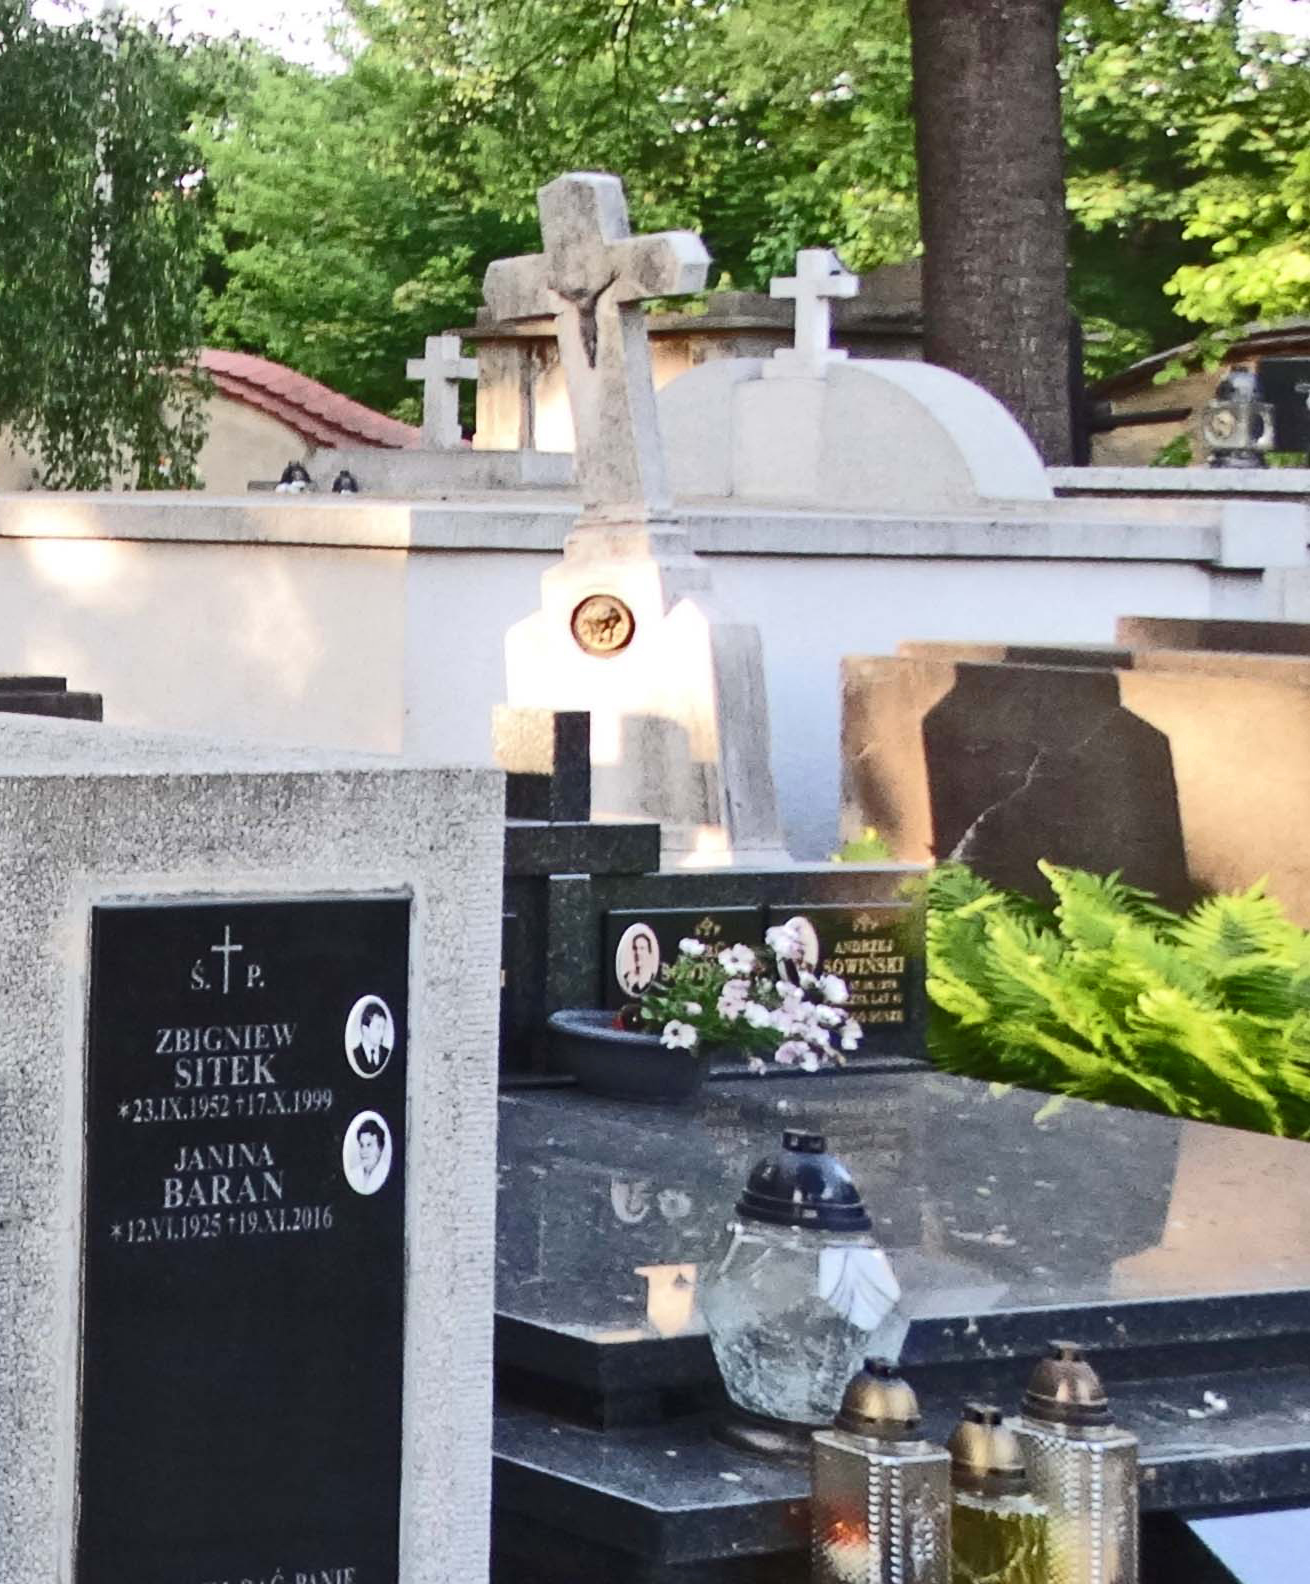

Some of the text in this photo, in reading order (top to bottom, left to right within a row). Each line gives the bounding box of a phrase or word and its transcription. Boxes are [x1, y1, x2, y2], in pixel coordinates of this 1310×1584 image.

[156, 1023, 297, 1054] ZBIGNIEW
[174, 1054, 276, 1088] SITEK
[174, 1142, 274, 1172] JANINA
[163, 1170, 284, 1208] BARAN
